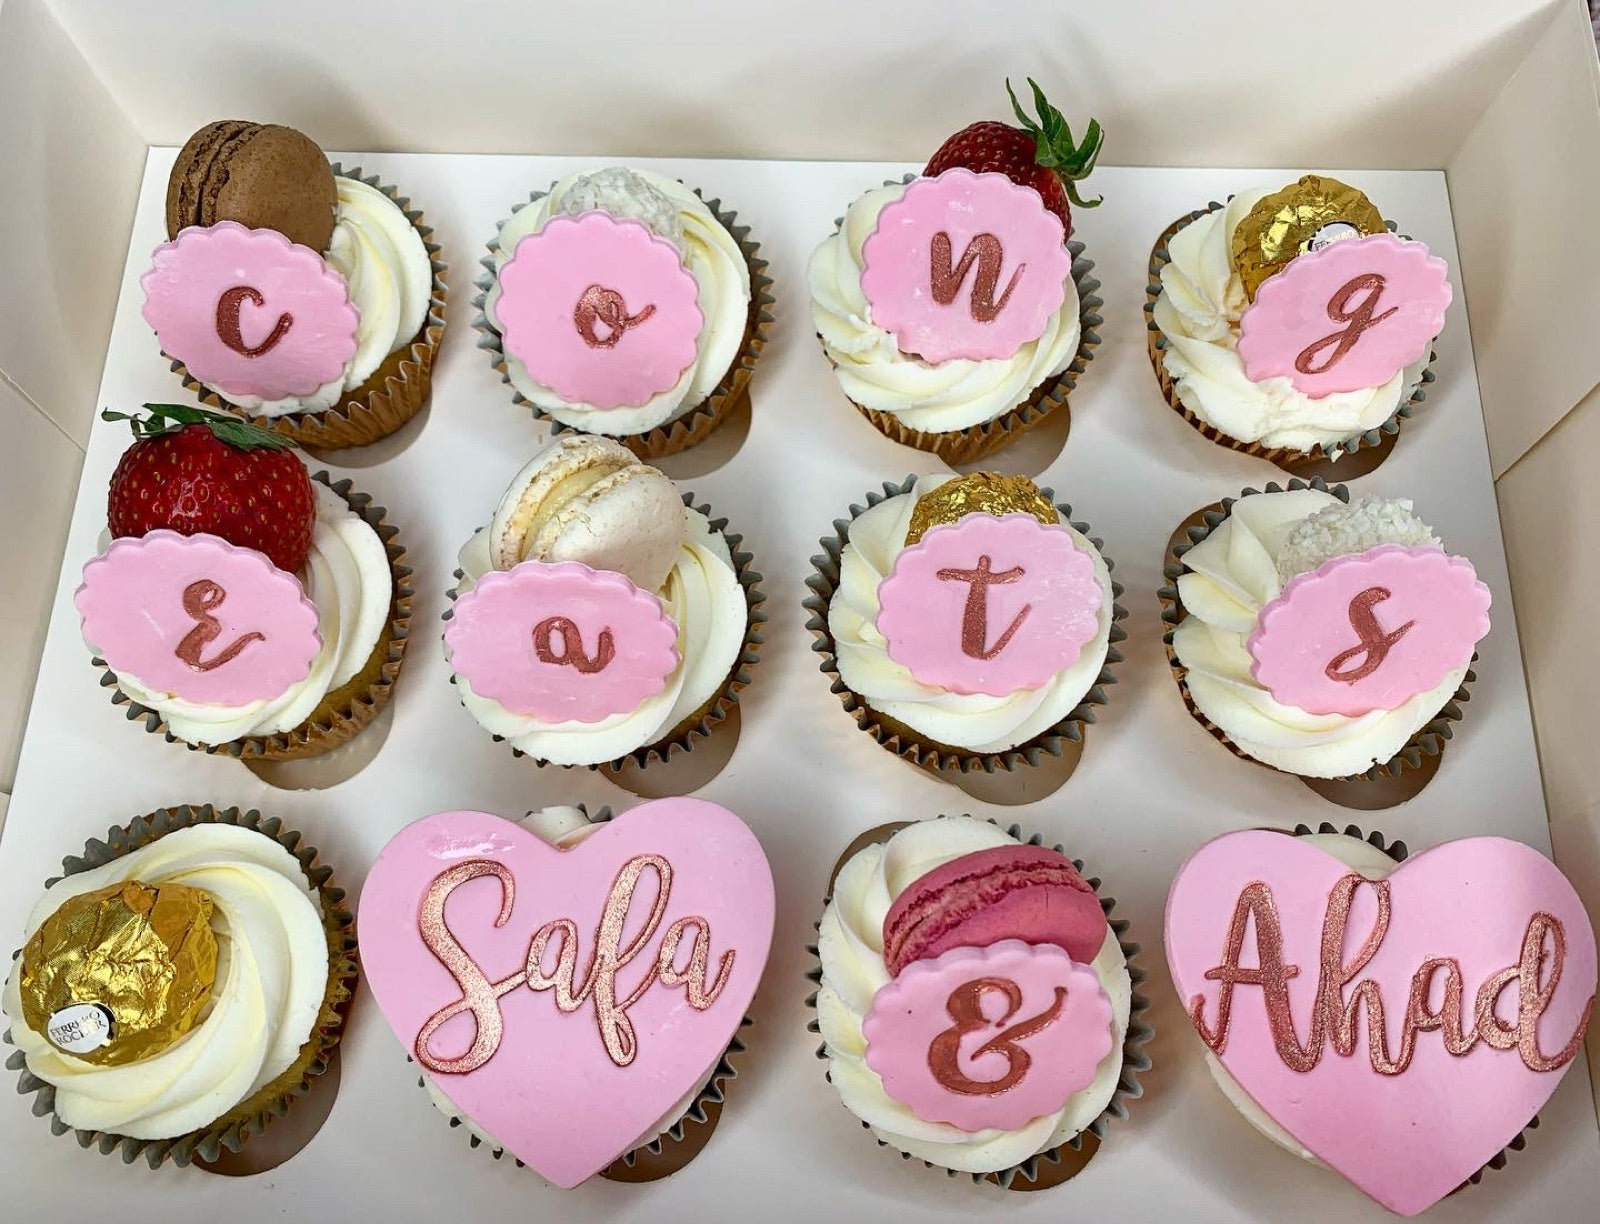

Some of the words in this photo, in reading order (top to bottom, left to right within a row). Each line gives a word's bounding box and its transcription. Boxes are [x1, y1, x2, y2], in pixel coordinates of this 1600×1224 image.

[930, 231, 1026, 324] n
[1295, 273, 1399, 374] g
[532, 616, 616, 675] a
[936, 555, 1031, 661] t
[1325, 586, 1415, 686] s
[414, 853, 737, 1075] Safa
[1190, 871, 1597, 1077] Ahad
[50, 1010, 101, 1037] FERRO
[927, 976, 1069, 1098] &
